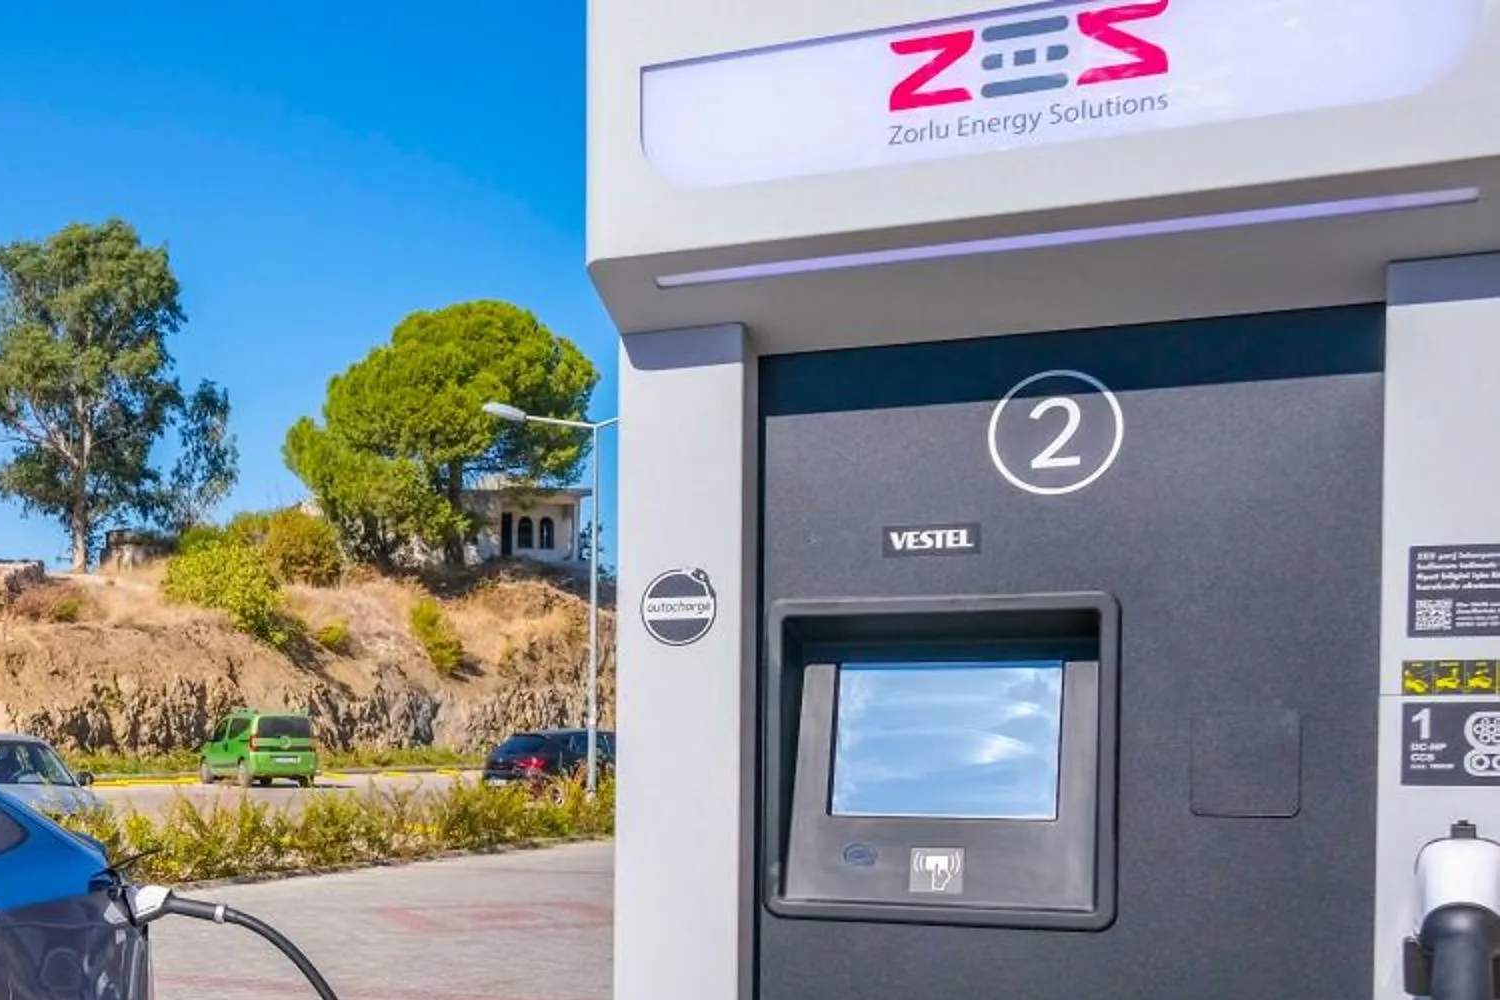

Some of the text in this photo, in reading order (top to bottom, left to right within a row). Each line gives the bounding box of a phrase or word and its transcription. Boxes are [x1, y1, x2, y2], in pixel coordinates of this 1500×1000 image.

[889, 0, 1169, 112] ZES
[889, 94, 1169, 146] Zorlu Energy Solutions
[1030, 397, 1081, 470] 2
[889, 528, 974, 551] VESTEL
[646, 601, 711, 615] autocharge
[1411, 707, 1431, 741] 1
[1409, 753, 1435, 763] CCS
